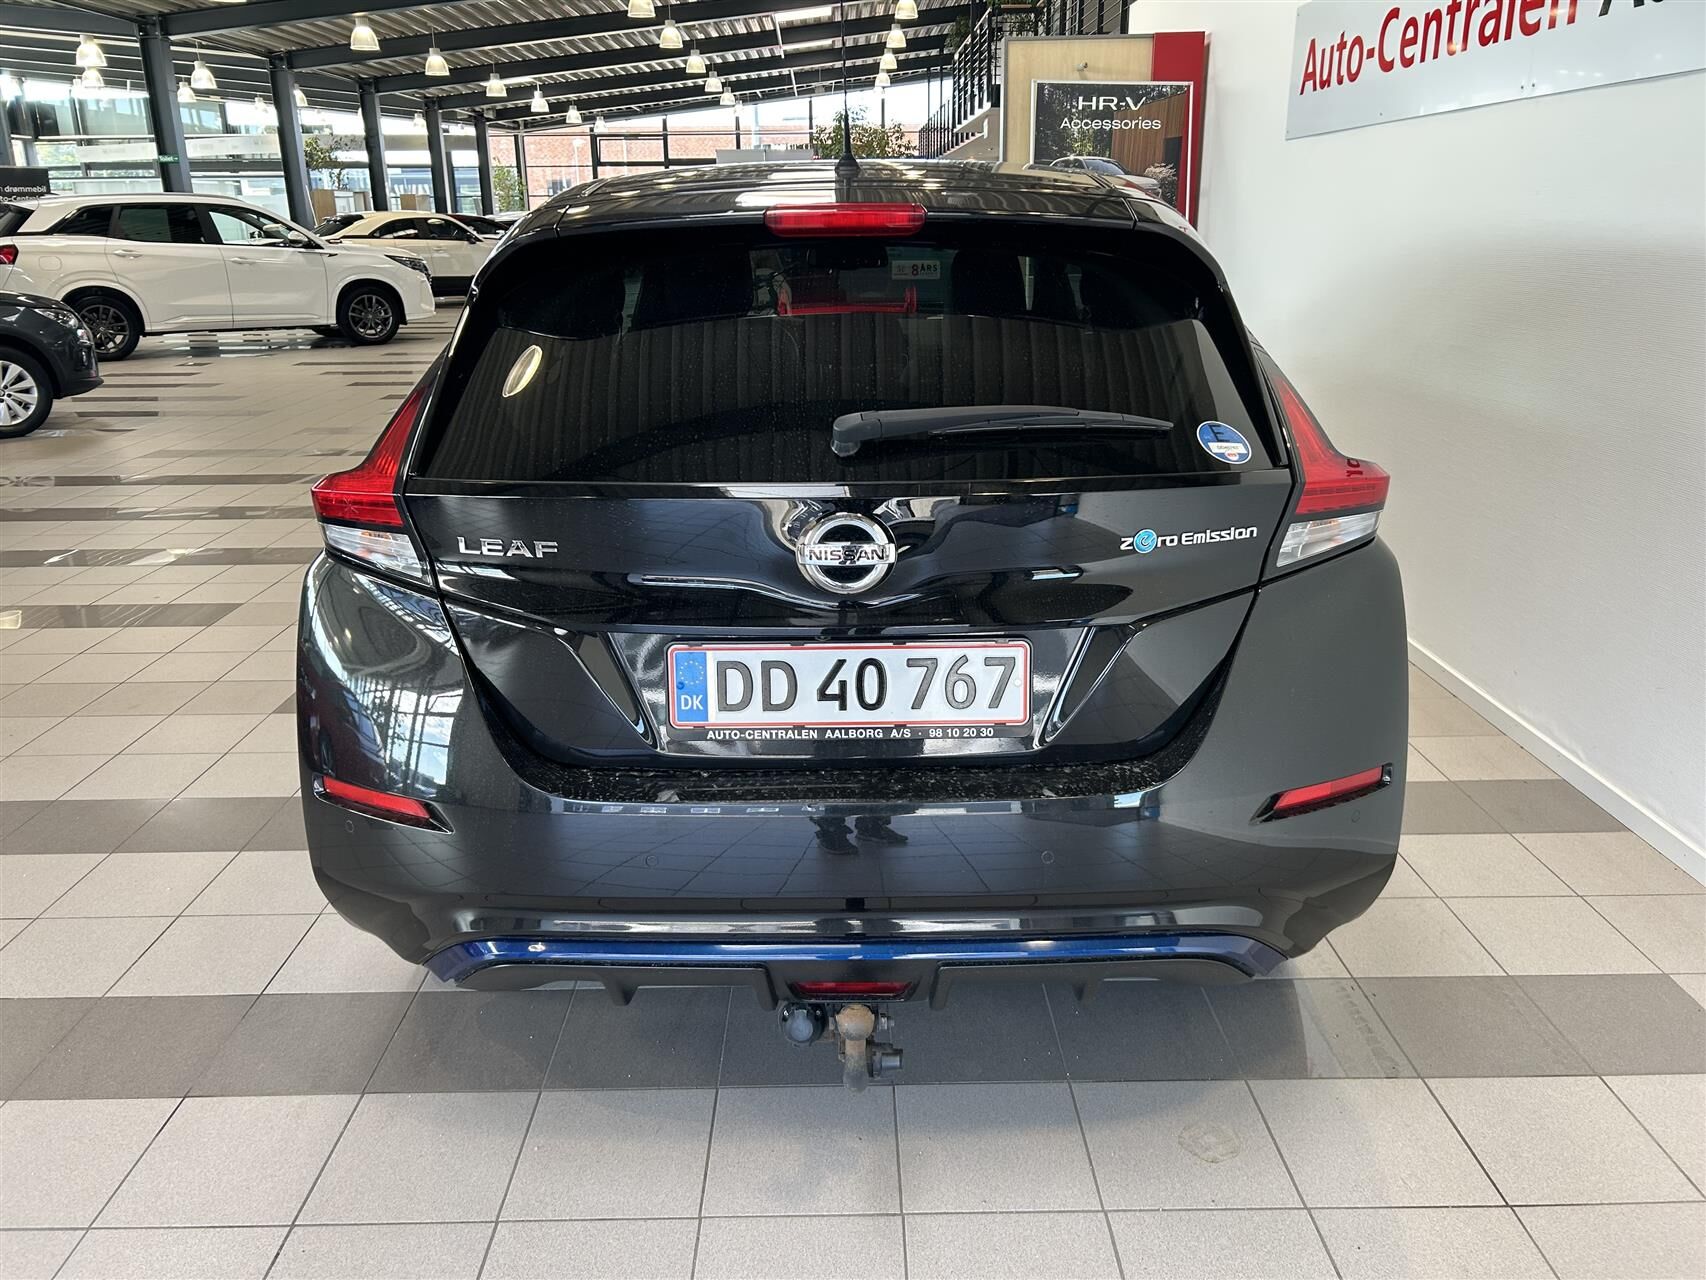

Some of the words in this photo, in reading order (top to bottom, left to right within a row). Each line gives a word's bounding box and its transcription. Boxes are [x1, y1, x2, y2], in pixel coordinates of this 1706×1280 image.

[1299, 0, 1578, 96] Auto-Centralen
[1077, 96, 1147, 111] HR-V
[1060, 116, 1162, 130] Accessories
[1181, 526, 1258, 545] Emission
[456, 536, 558, 558] LEAF
[808, 548, 885, 561] NISSAN
[716, 660, 798, 713] DD
[816, 658, 888, 712] 40
[906, 654, 1017, 711] 767
[680, 694, 704, 711] DK
[706, 729, 818, 740] AUTO-CENTRALEN
[825, 728, 883, 739] AALBORG
[890, 728, 911, 738] A/S
[928, 727, 943, 738] 98
[946, 727, 960, 738] 10
[963, 727, 977, 737] 20
[980, 727, 994, 737] 30
